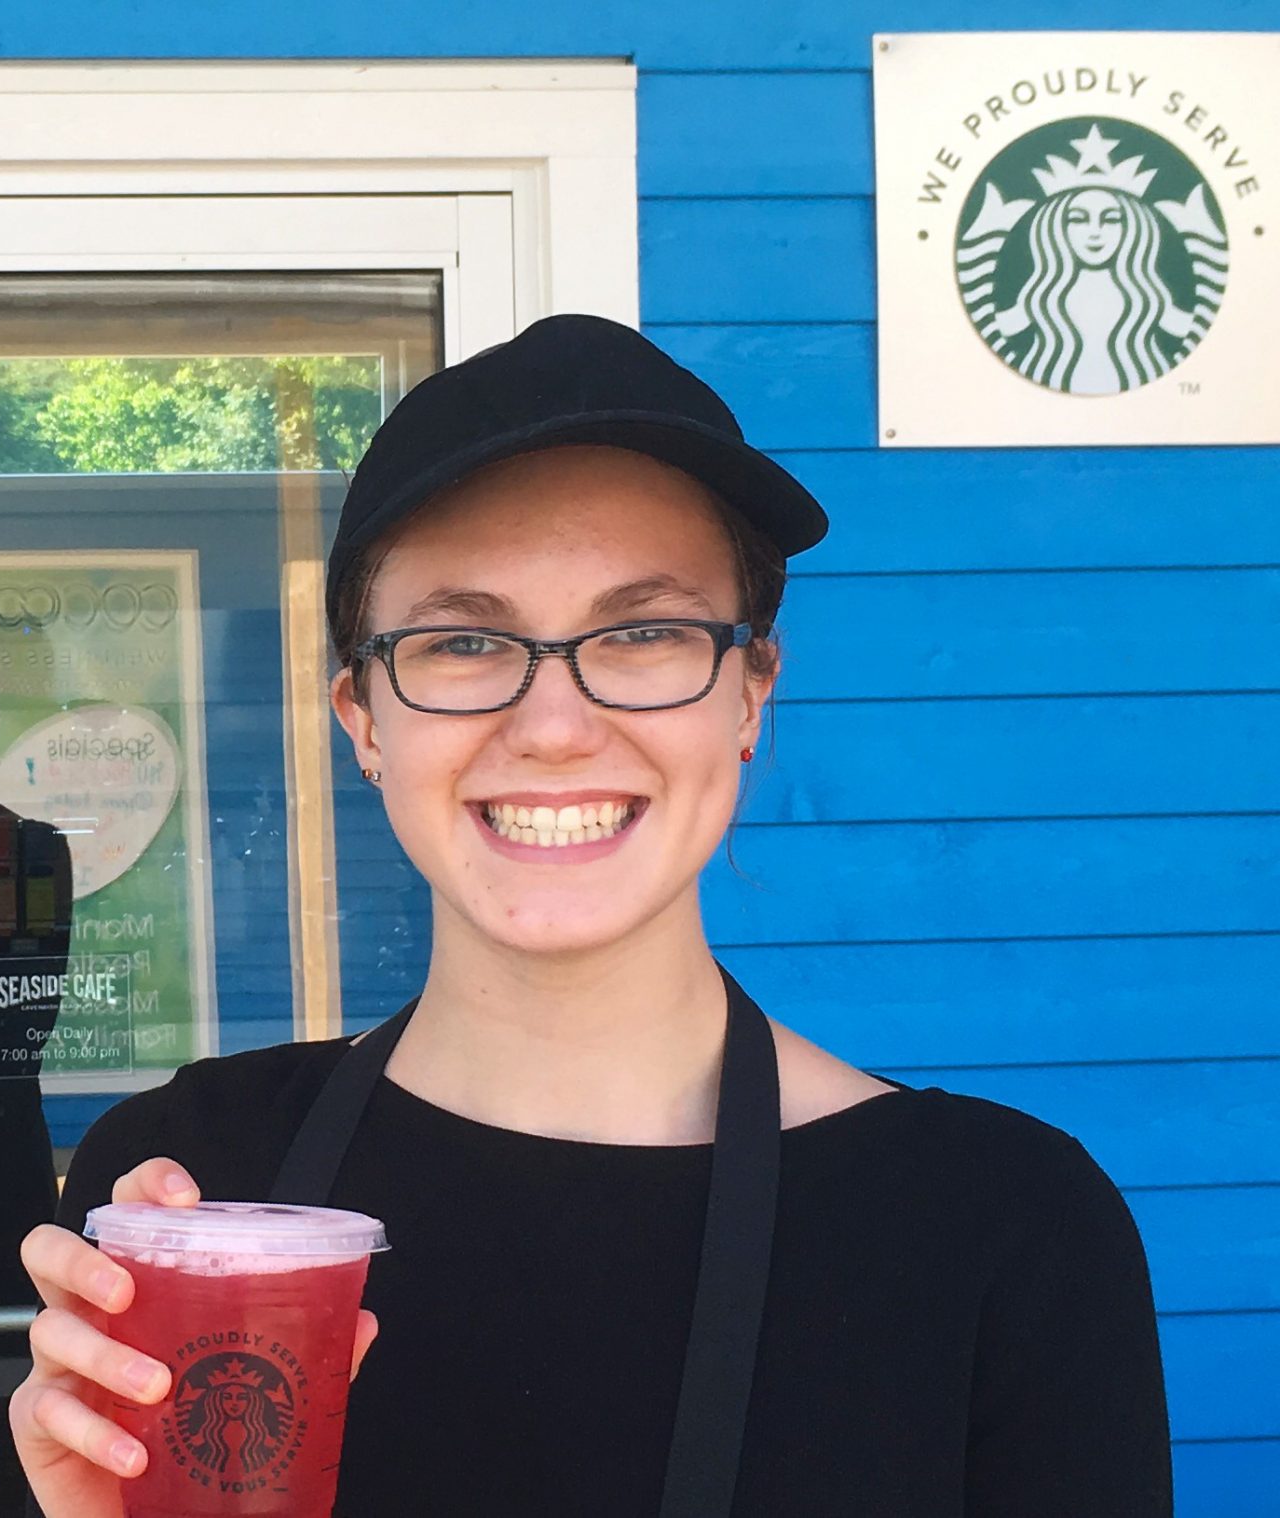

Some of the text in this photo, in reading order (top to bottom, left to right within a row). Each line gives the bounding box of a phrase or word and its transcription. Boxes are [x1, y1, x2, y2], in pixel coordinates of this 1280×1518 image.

[918, 67, 1261, 206] WE PROUDLY SERVE
[1179, 382, 1201, 395] TM
[73, 967, 117, 1004] CAFÉ
[26, 1026, 93, 1041] Open Daily
[1, 1048, 120, 1061] 7:00 am to 9:00 pm
[176, 1331, 264, 1360] PROUDLY
[270, 1342, 308, 1389] SERVE
[220, 1477, 266, 1494] VOUS
